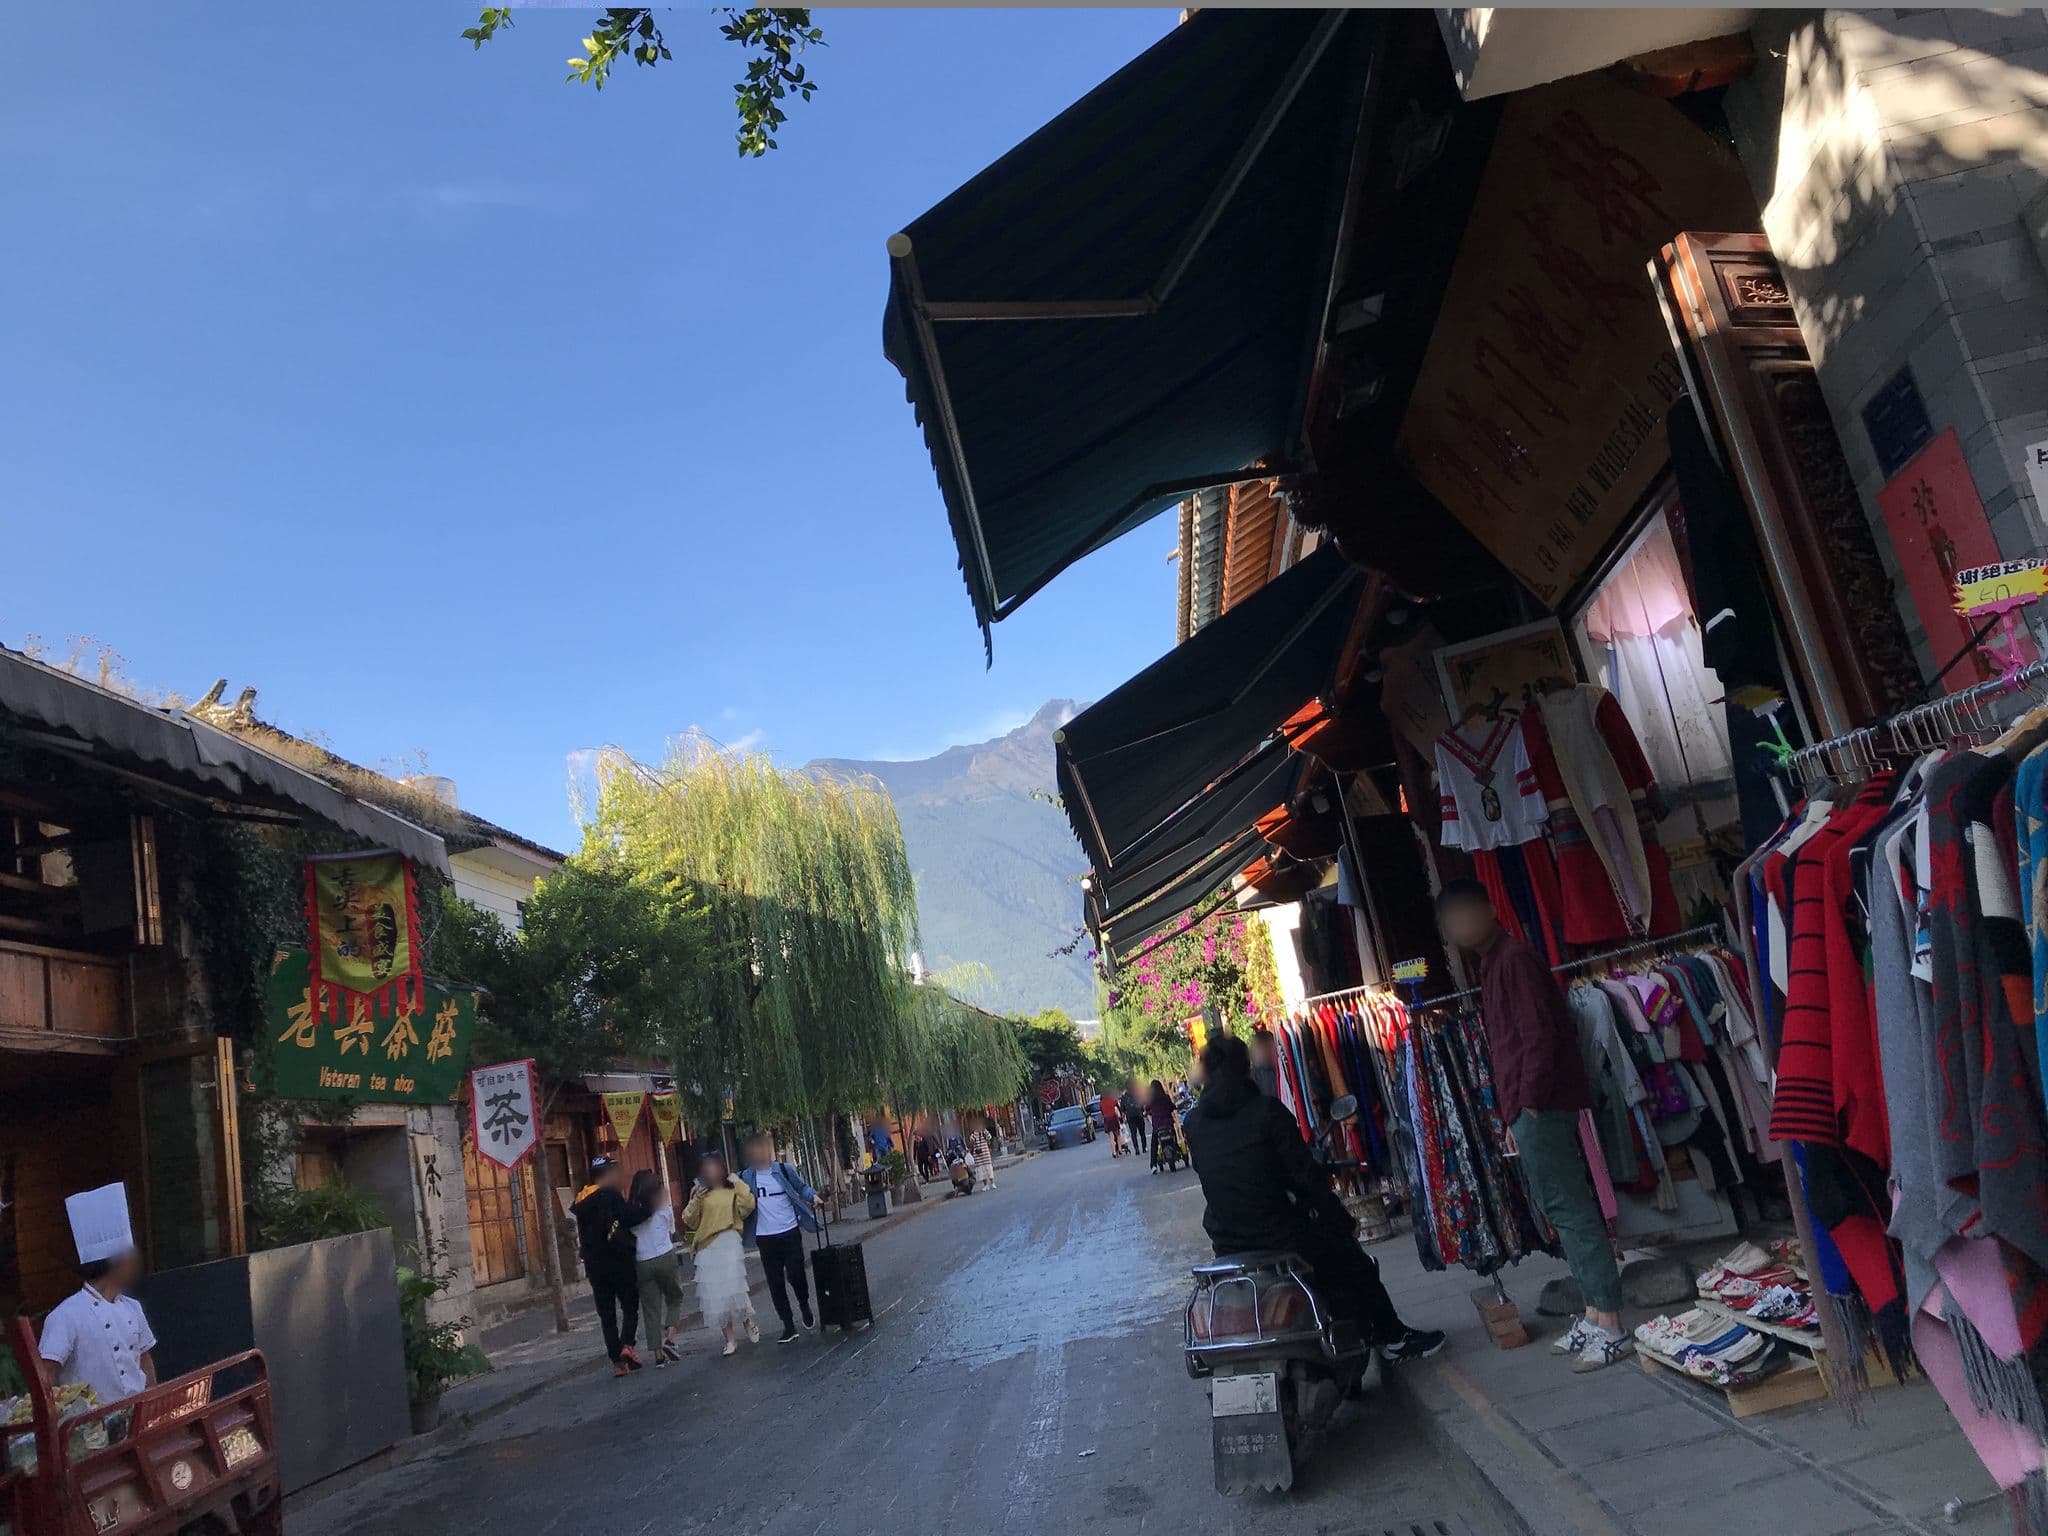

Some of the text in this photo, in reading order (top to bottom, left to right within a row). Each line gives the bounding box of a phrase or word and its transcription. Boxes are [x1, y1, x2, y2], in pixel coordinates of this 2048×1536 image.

[370, 1072, 388, 1091] tea
[394, 1073, 415, 1094] shop
[482, 1088, 529, 1146] 茶
